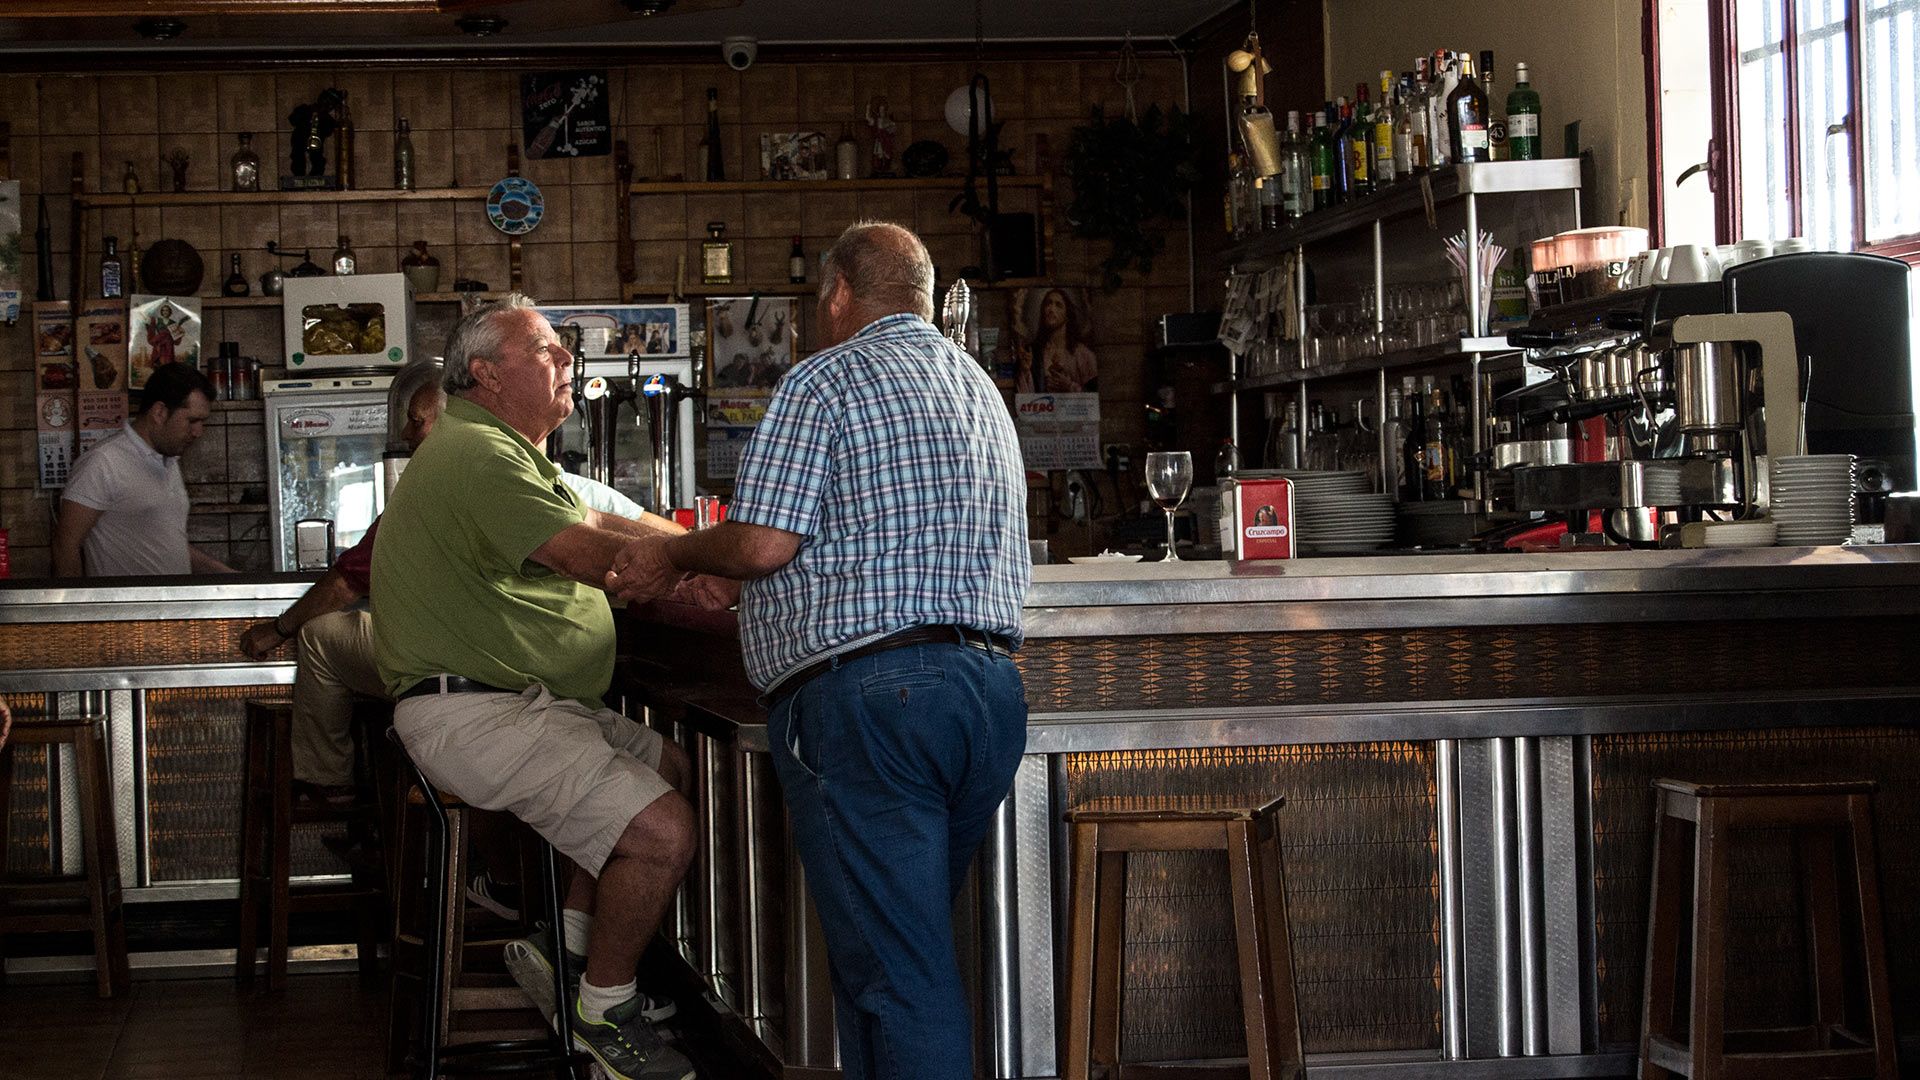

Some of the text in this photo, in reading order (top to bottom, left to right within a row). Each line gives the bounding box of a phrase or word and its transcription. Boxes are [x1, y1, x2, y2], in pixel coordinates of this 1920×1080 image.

[538, 98, 557, 110] zero
[1490, 126, 1504, 139] 43
[1248, 528, 1285, 536] Cruzcampo
